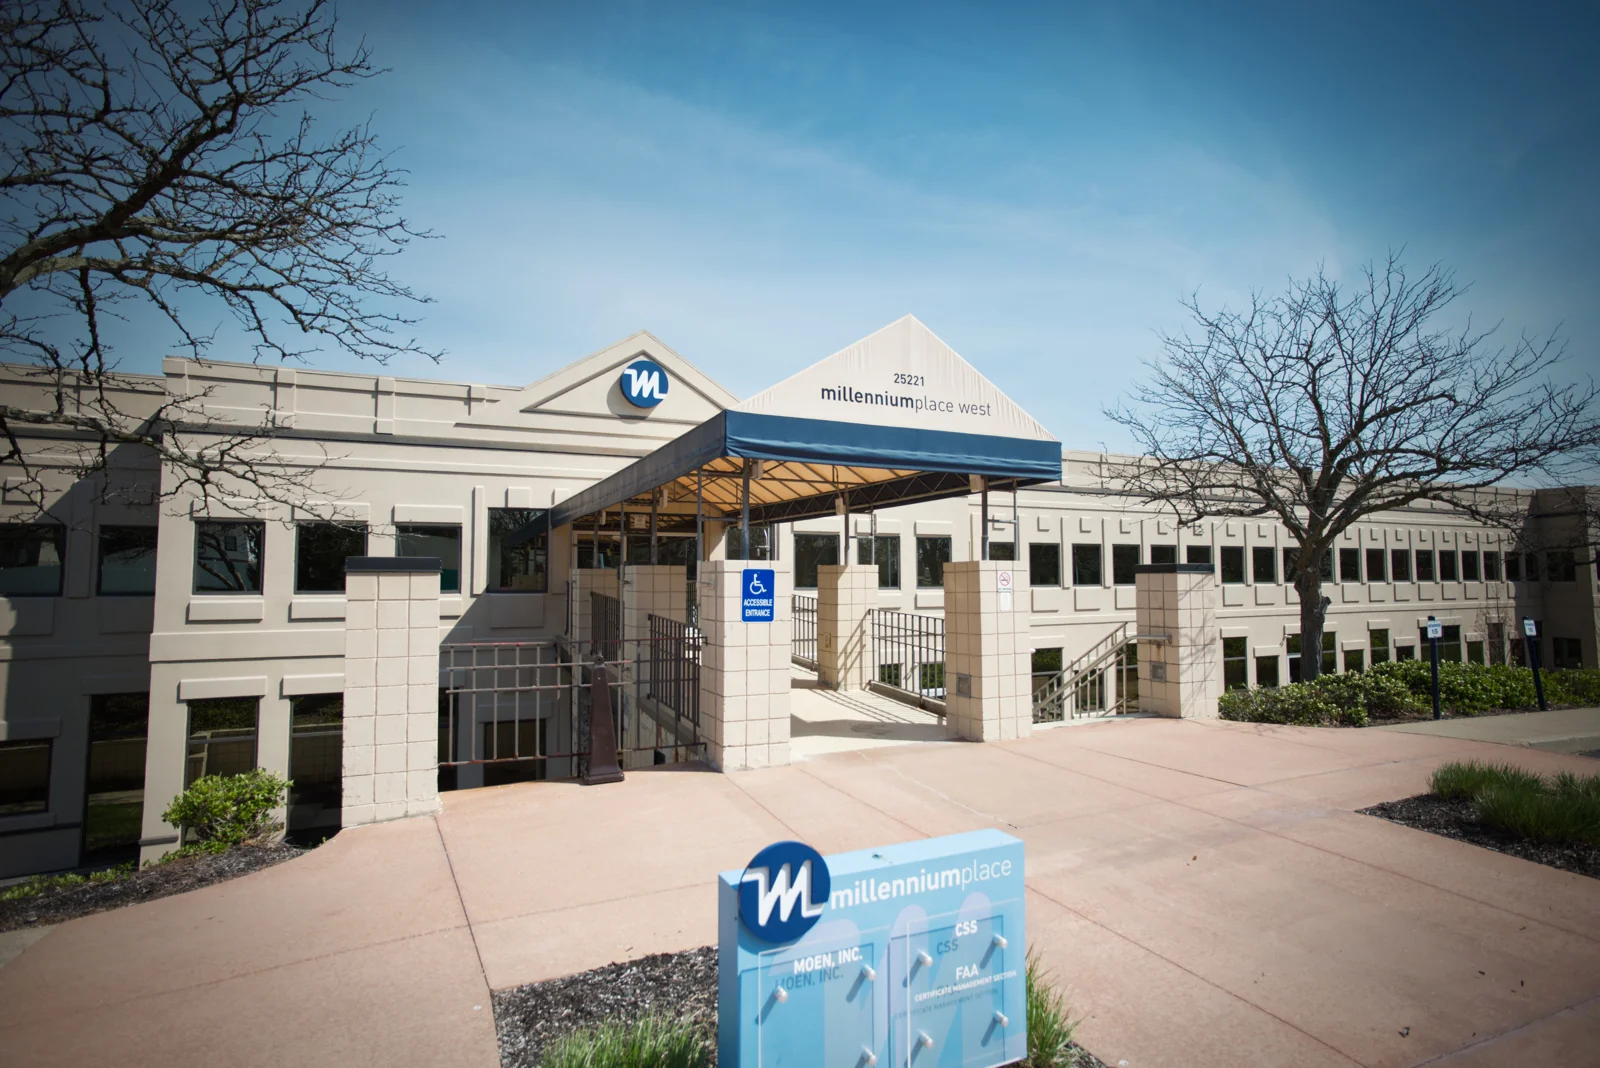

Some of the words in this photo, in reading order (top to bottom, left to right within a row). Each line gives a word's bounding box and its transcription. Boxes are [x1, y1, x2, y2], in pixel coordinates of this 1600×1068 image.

[893, 373, 924, 386] 25221
[820, 385, 954, 413] millenniumplace
[958, 402, 992, 416] west
[745, 609, 771, 617] ENTRANCE
[830, 858, 1012, 910] millenniumplace
[955, 919, 978, 937] CSS
[838, 946, 863, 965] INC.
[955, 963, 979, 981] FAA
[914, 986, 951, 1002] CERTIFICATE
[952, 975, 992, 992] MANAGEMENT
[994, 970, 1017, 982] SECTION
